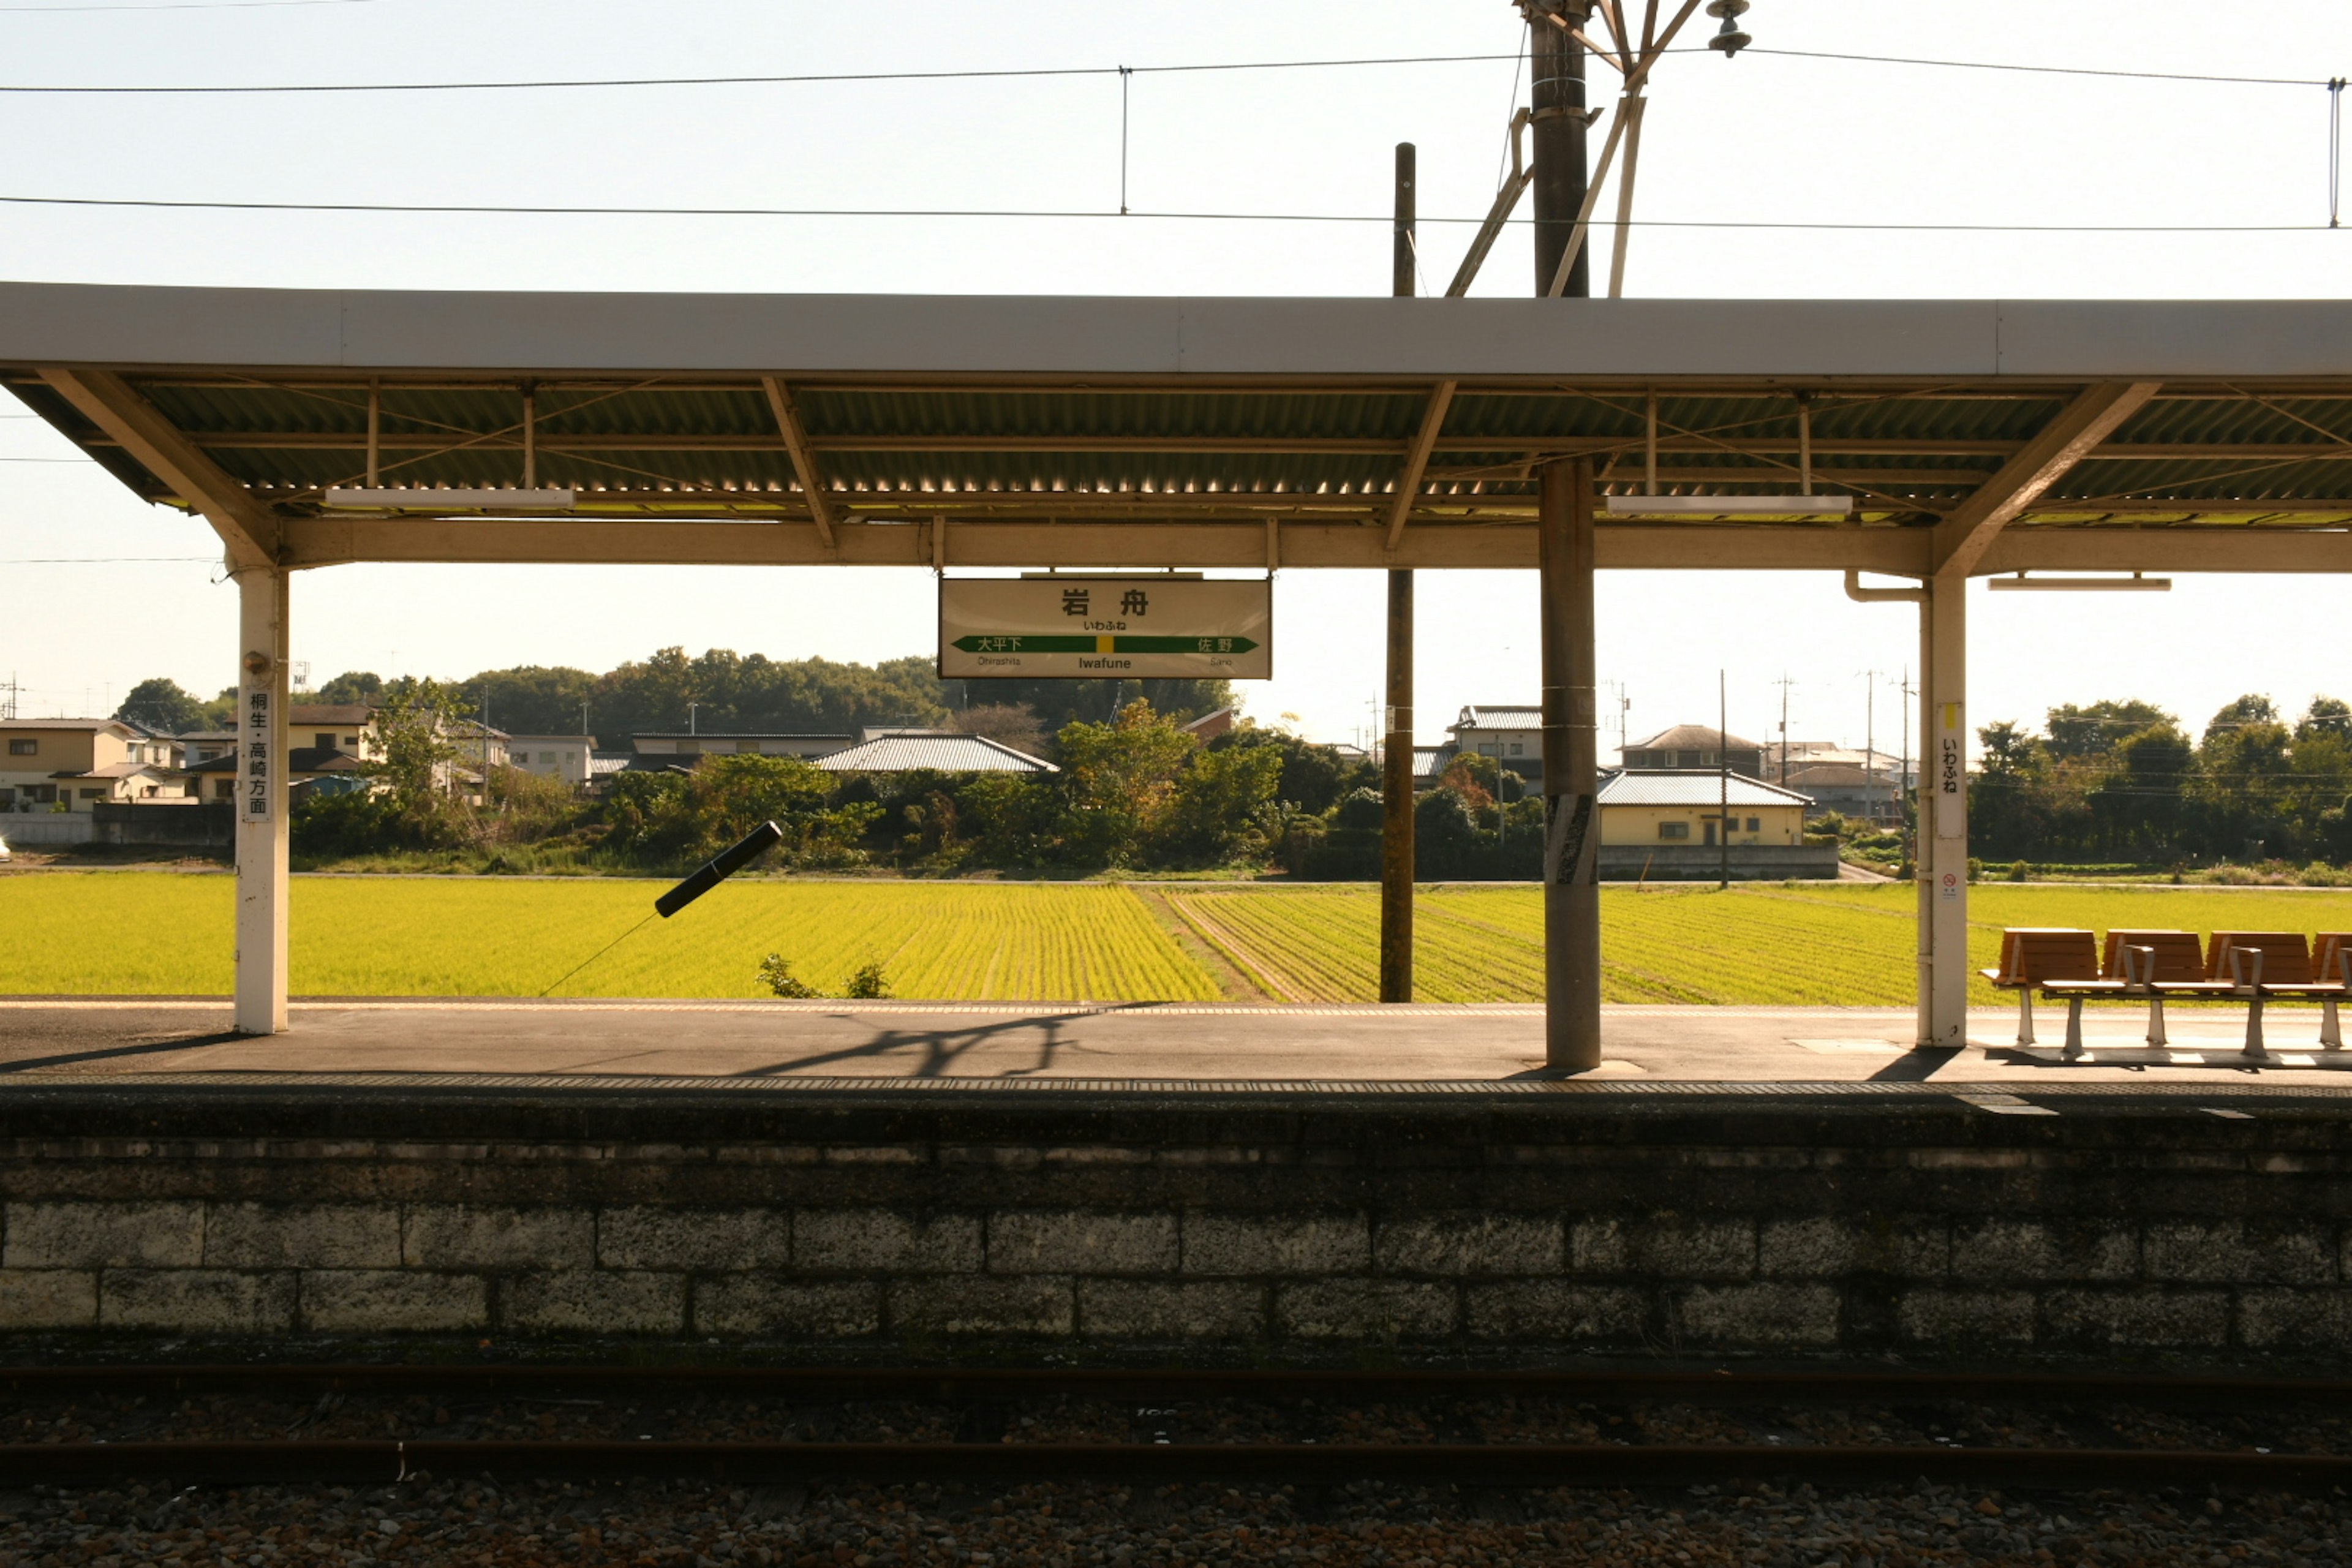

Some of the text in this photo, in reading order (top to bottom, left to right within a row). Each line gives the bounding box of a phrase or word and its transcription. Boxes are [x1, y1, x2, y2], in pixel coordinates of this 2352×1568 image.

[1062, 588, 1148, 616] 岩舟
[1084, 621, 1126, 631] いわふね
[978, 637, 1022, 652] 大平下
[1198, 638, 1232, 652] 佐野
[1079, 657, 1131, 668] Iwafune
[1210, 657, 1232, 666] Sano
[250, 693, 267, 814] 桐生・高崎方面
[1943, 739, 1957, 793] いわふね
